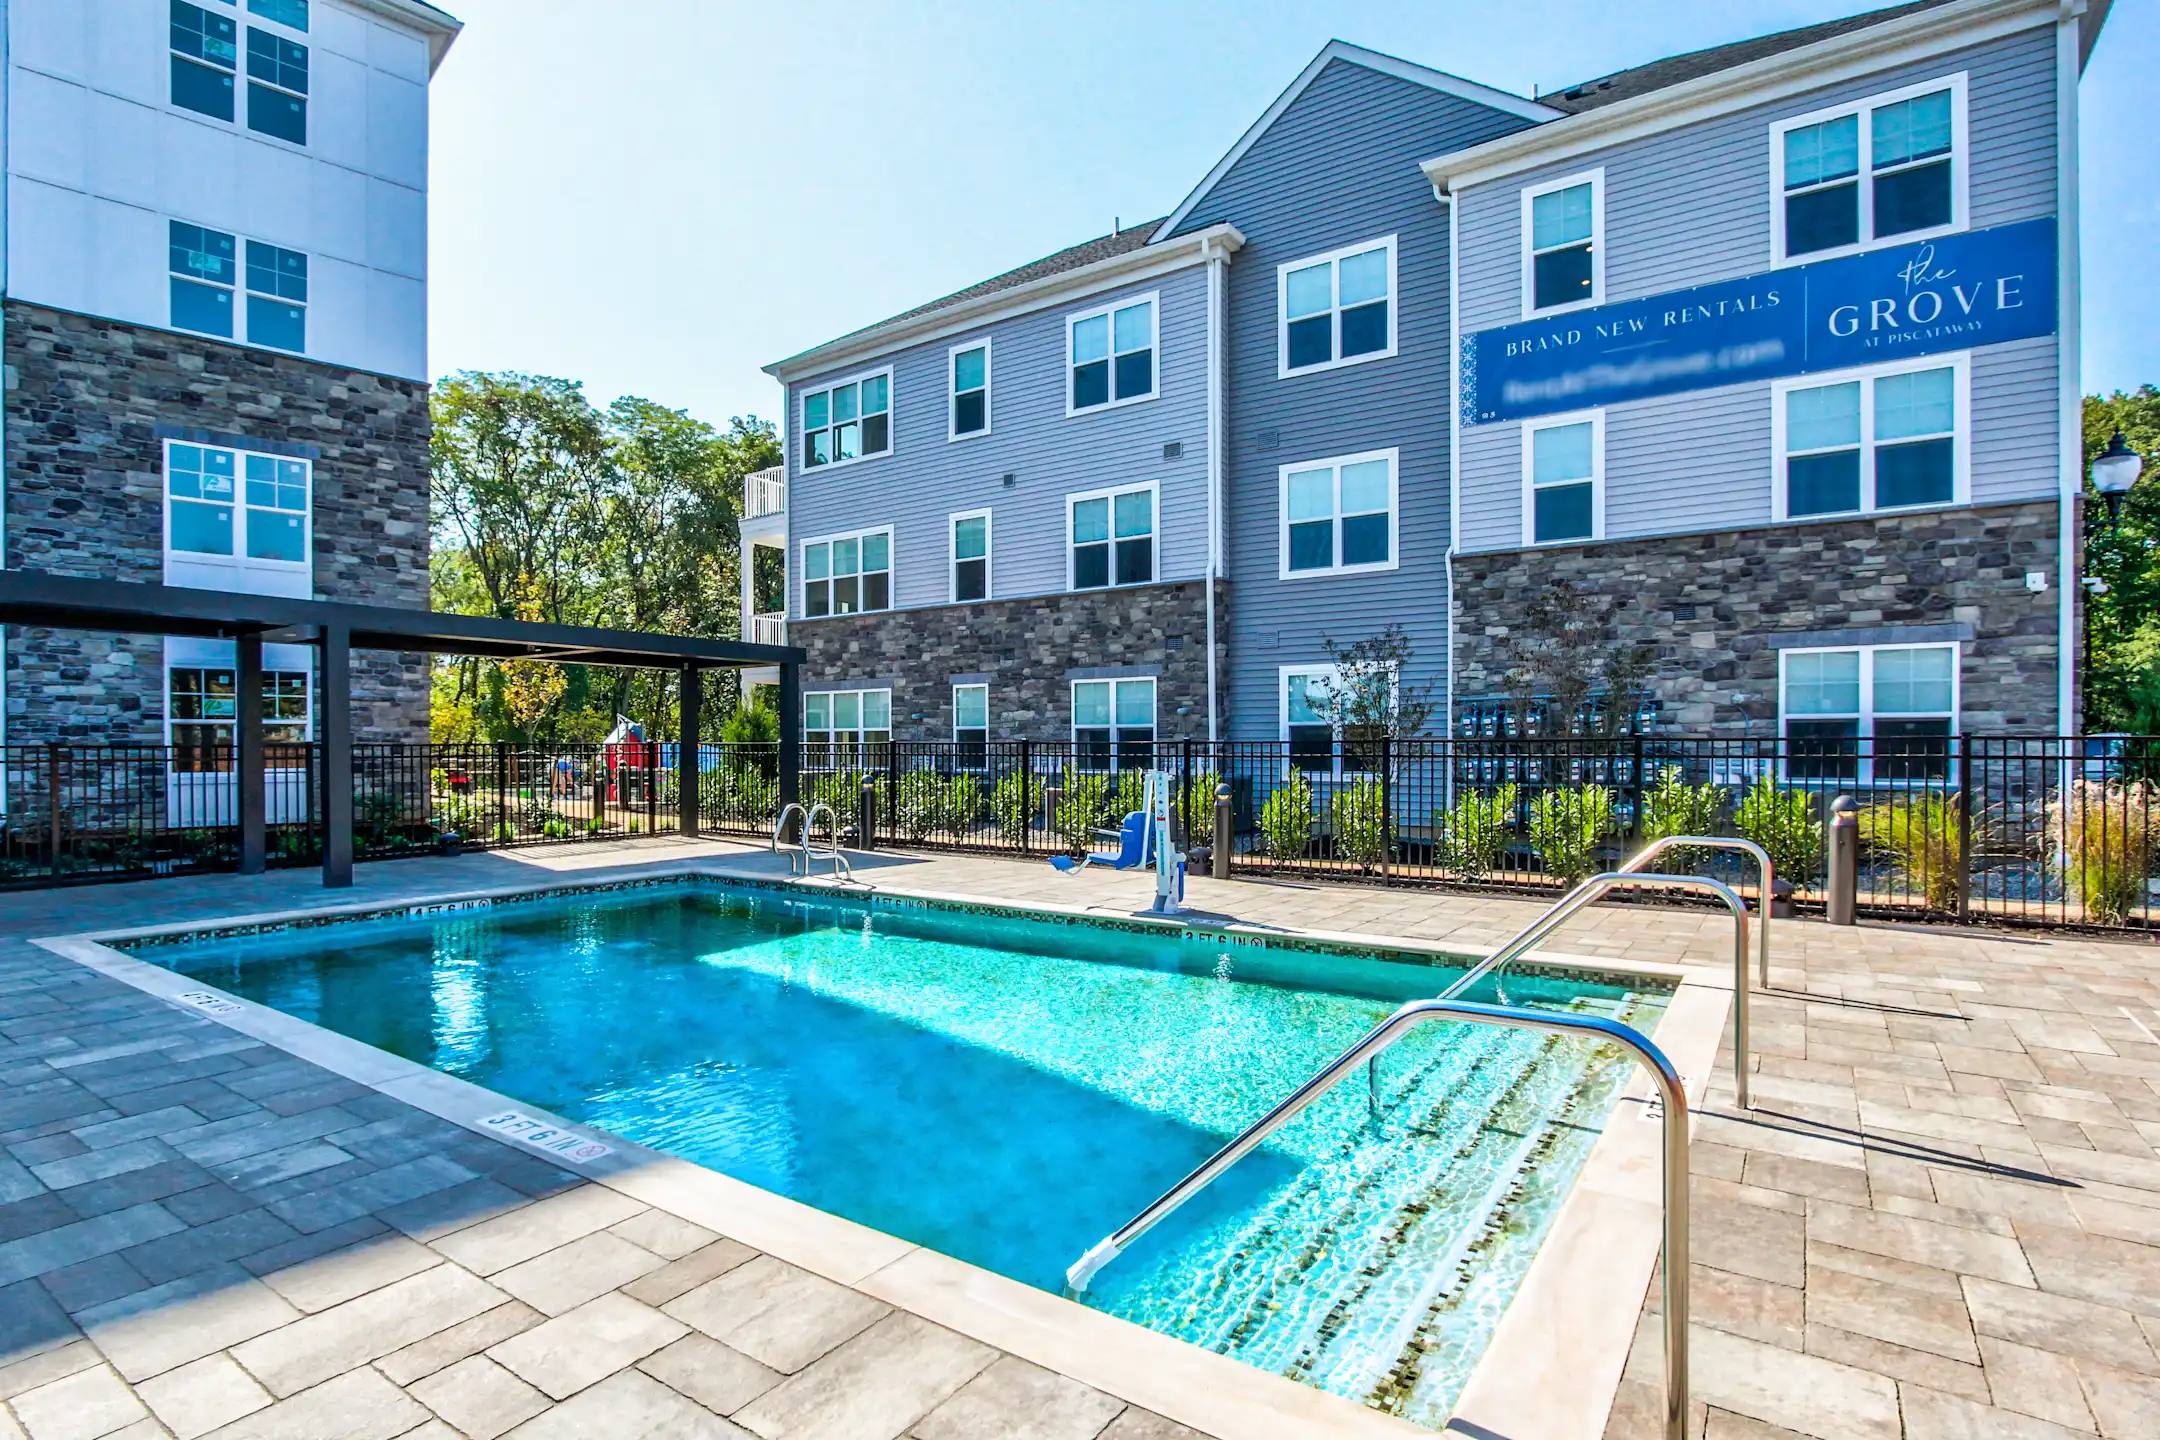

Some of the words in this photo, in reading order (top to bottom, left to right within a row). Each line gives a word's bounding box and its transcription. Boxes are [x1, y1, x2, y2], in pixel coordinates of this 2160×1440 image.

[1896, 244, 1957, 297] the
[1828, 274, 2034, 337] GROVE
[1506, 329, 1581, 357] BRAND
[1596, 315, 1648, 340] NEW
[1663, 290, 1781, 327] RENTALS
[1863, 336, 1880, 348] AT
[1888, 320, 1985, 345] PISCATAWAY
[488, 1114, 518, 1125] 3
[502, 1120, 542, 1135] FT
[527, 1129, 559, 1142] 6
